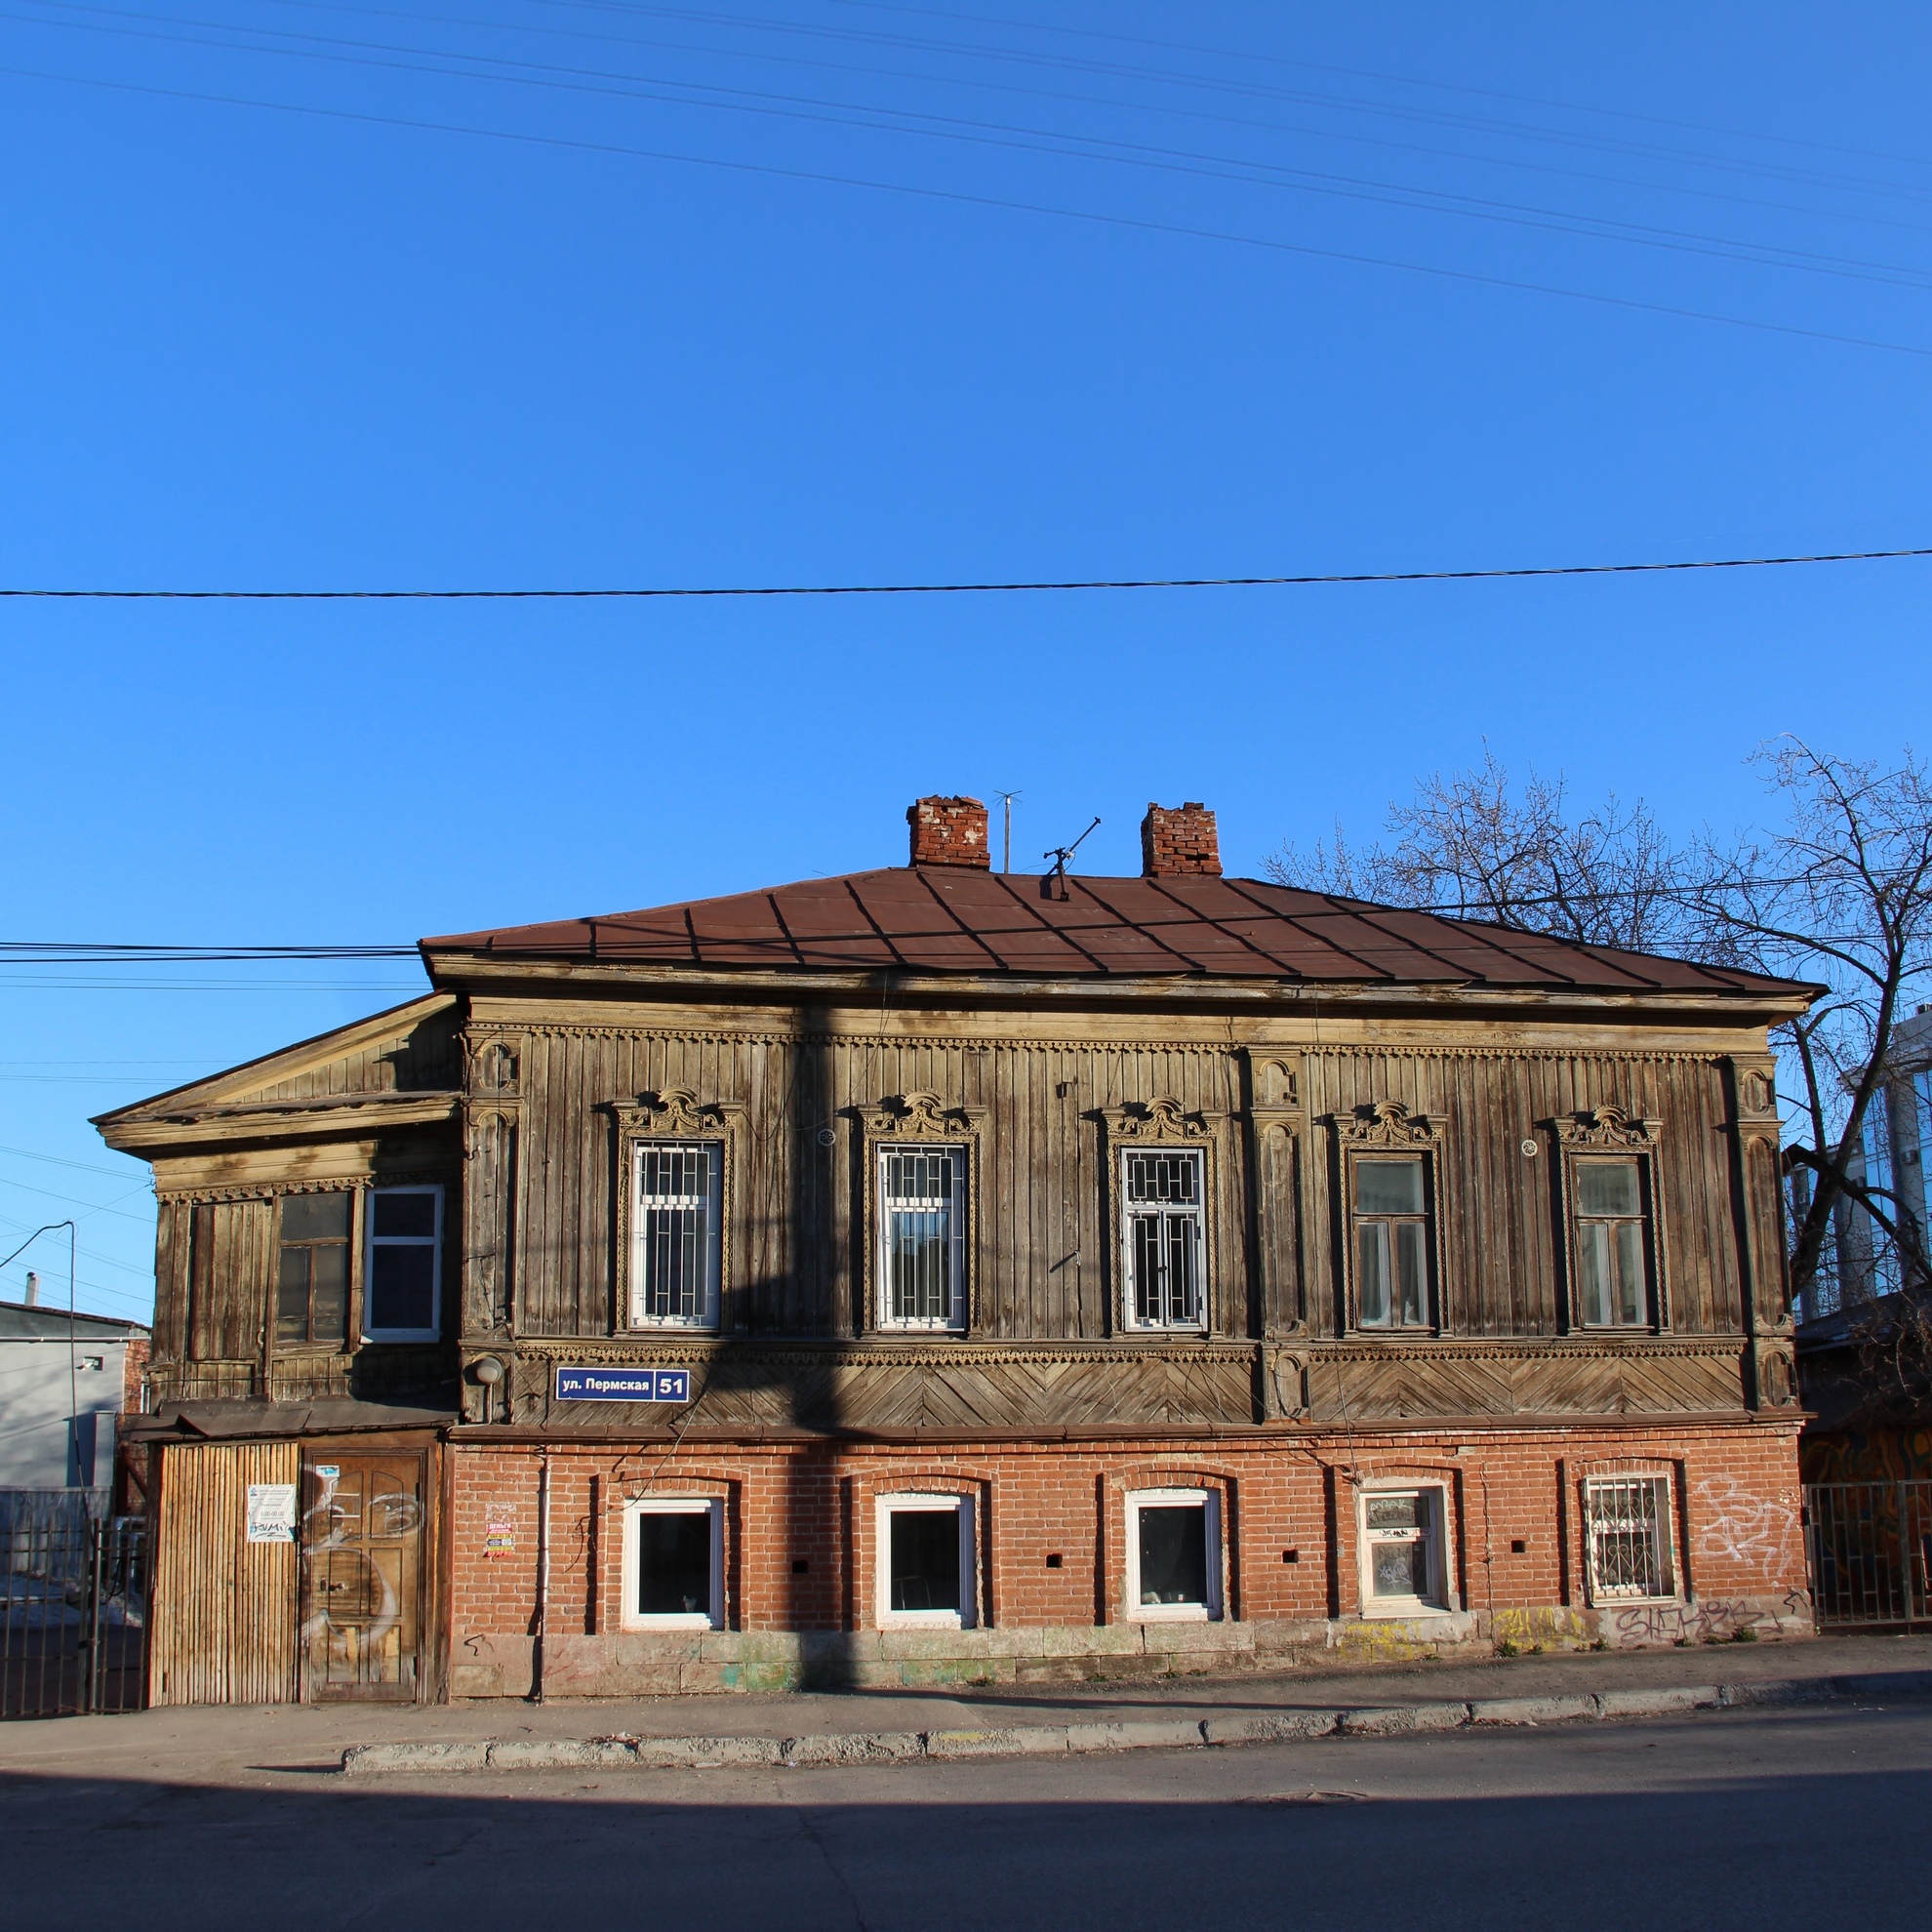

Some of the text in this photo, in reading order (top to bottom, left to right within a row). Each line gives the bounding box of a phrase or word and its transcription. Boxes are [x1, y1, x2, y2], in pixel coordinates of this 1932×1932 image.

[562, 1377, 683, 1394] ул. Пермская 51
